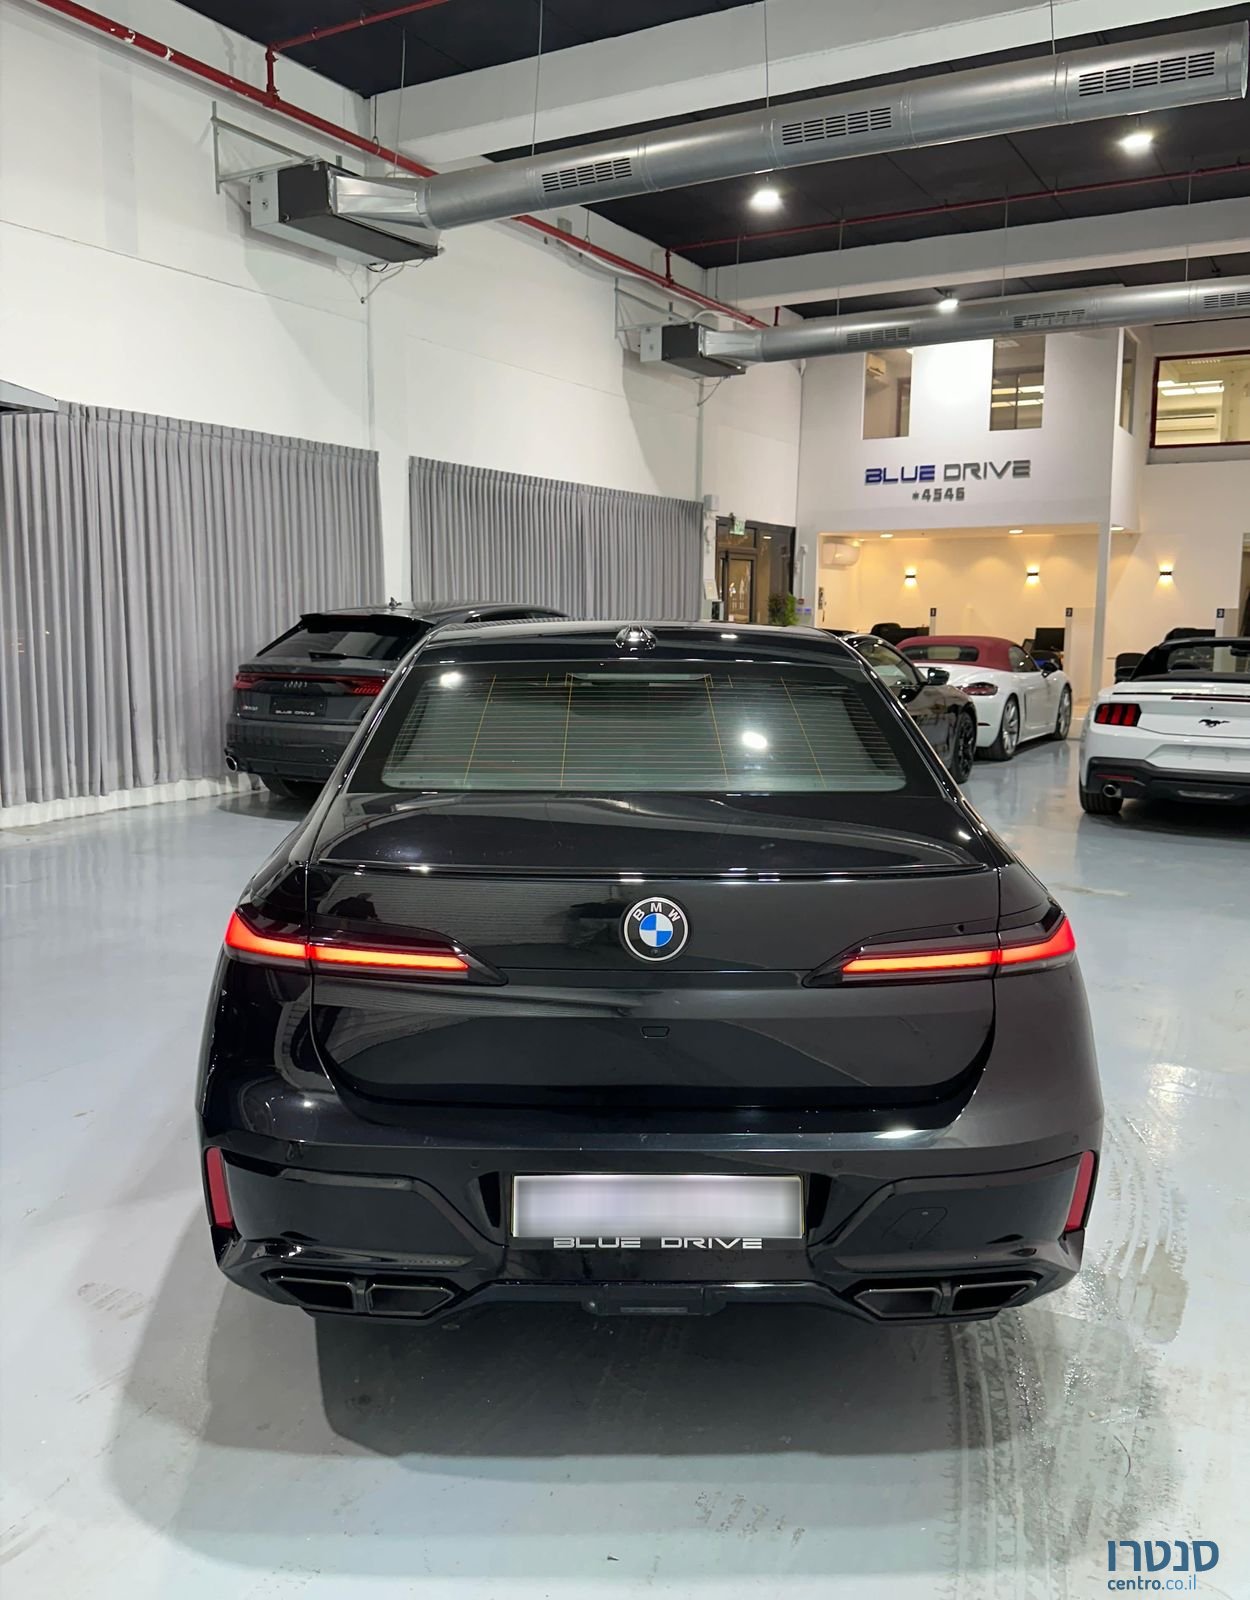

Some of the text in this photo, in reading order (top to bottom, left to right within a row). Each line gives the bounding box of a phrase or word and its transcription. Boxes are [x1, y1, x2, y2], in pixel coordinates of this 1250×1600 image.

[864, 460, 1031, 485] BLUE DRIVE
[633, 902, 680, 922] BMW
[553, 1237, 762, 1250] BLUE DRIVE
